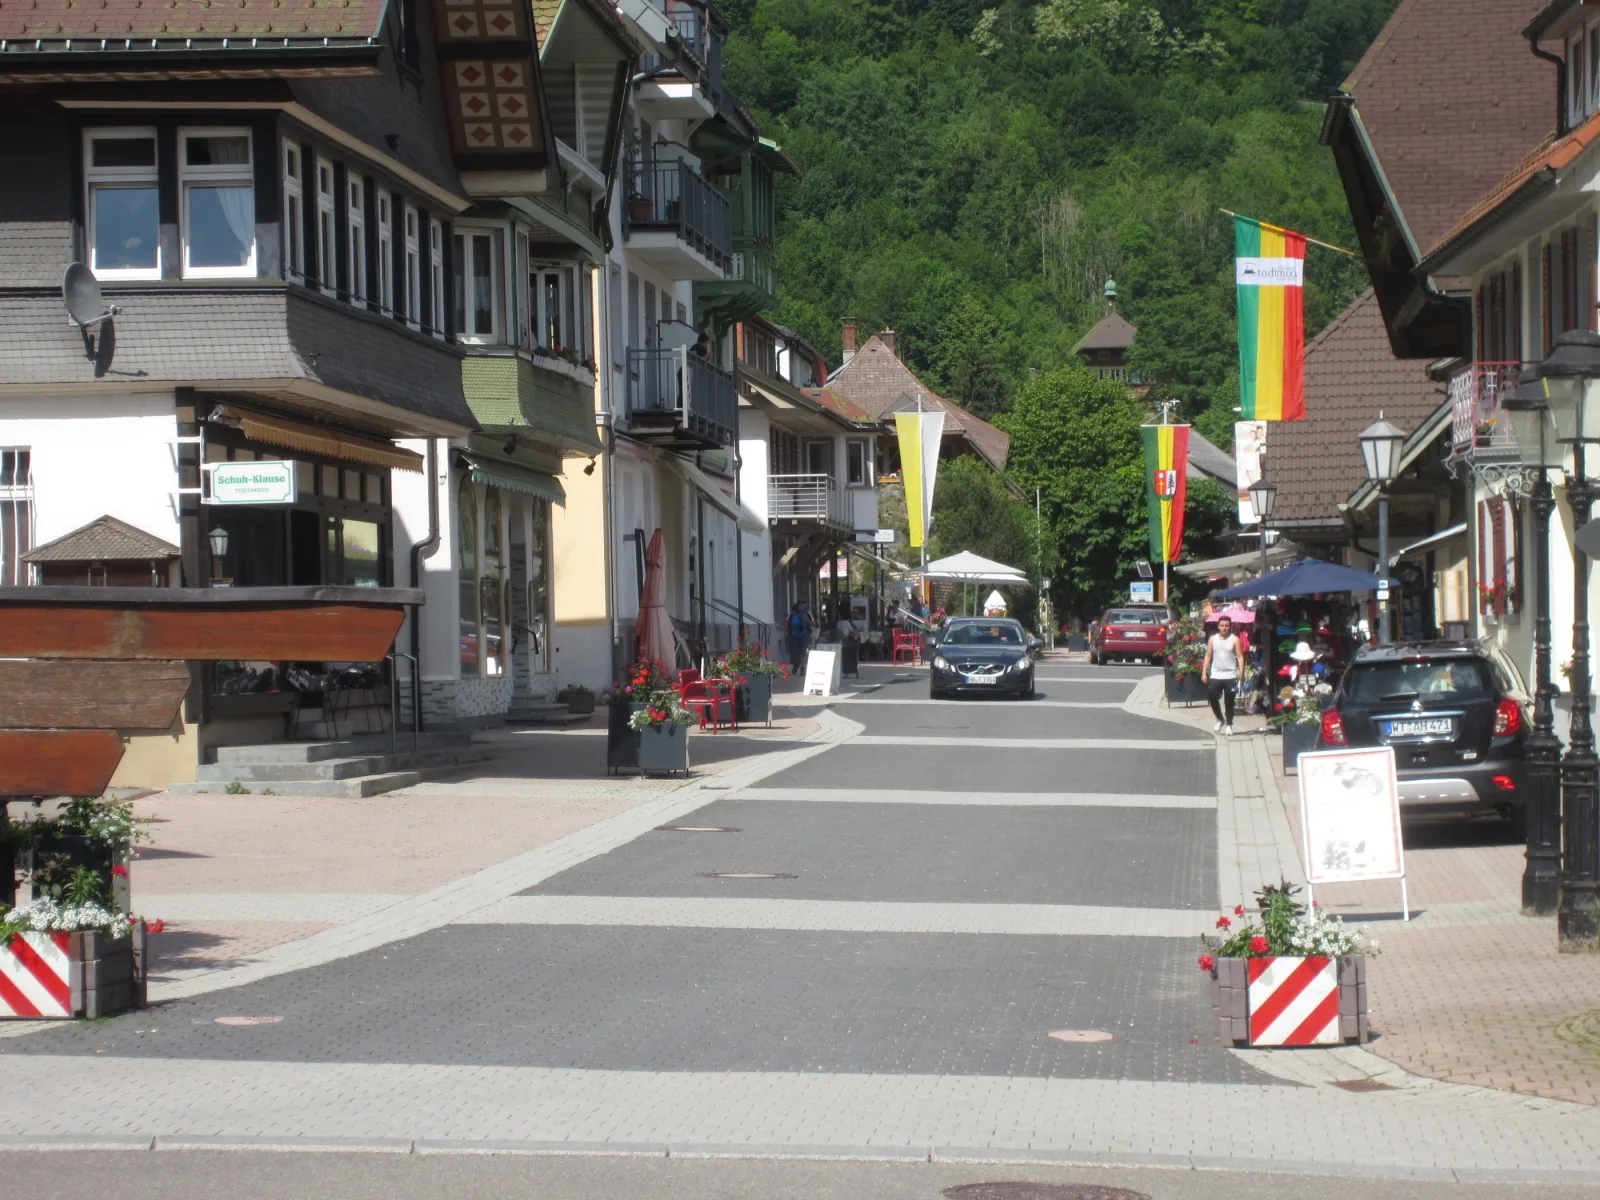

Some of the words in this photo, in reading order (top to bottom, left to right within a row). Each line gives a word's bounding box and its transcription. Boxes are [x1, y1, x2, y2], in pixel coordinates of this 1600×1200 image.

[217, 474, 286, 485] Schuh-Klause
[1392, 721, 1405, 733] WT
[1414, 720, 1428, 732] AH
[1430, 719, 1450, 731] 471
